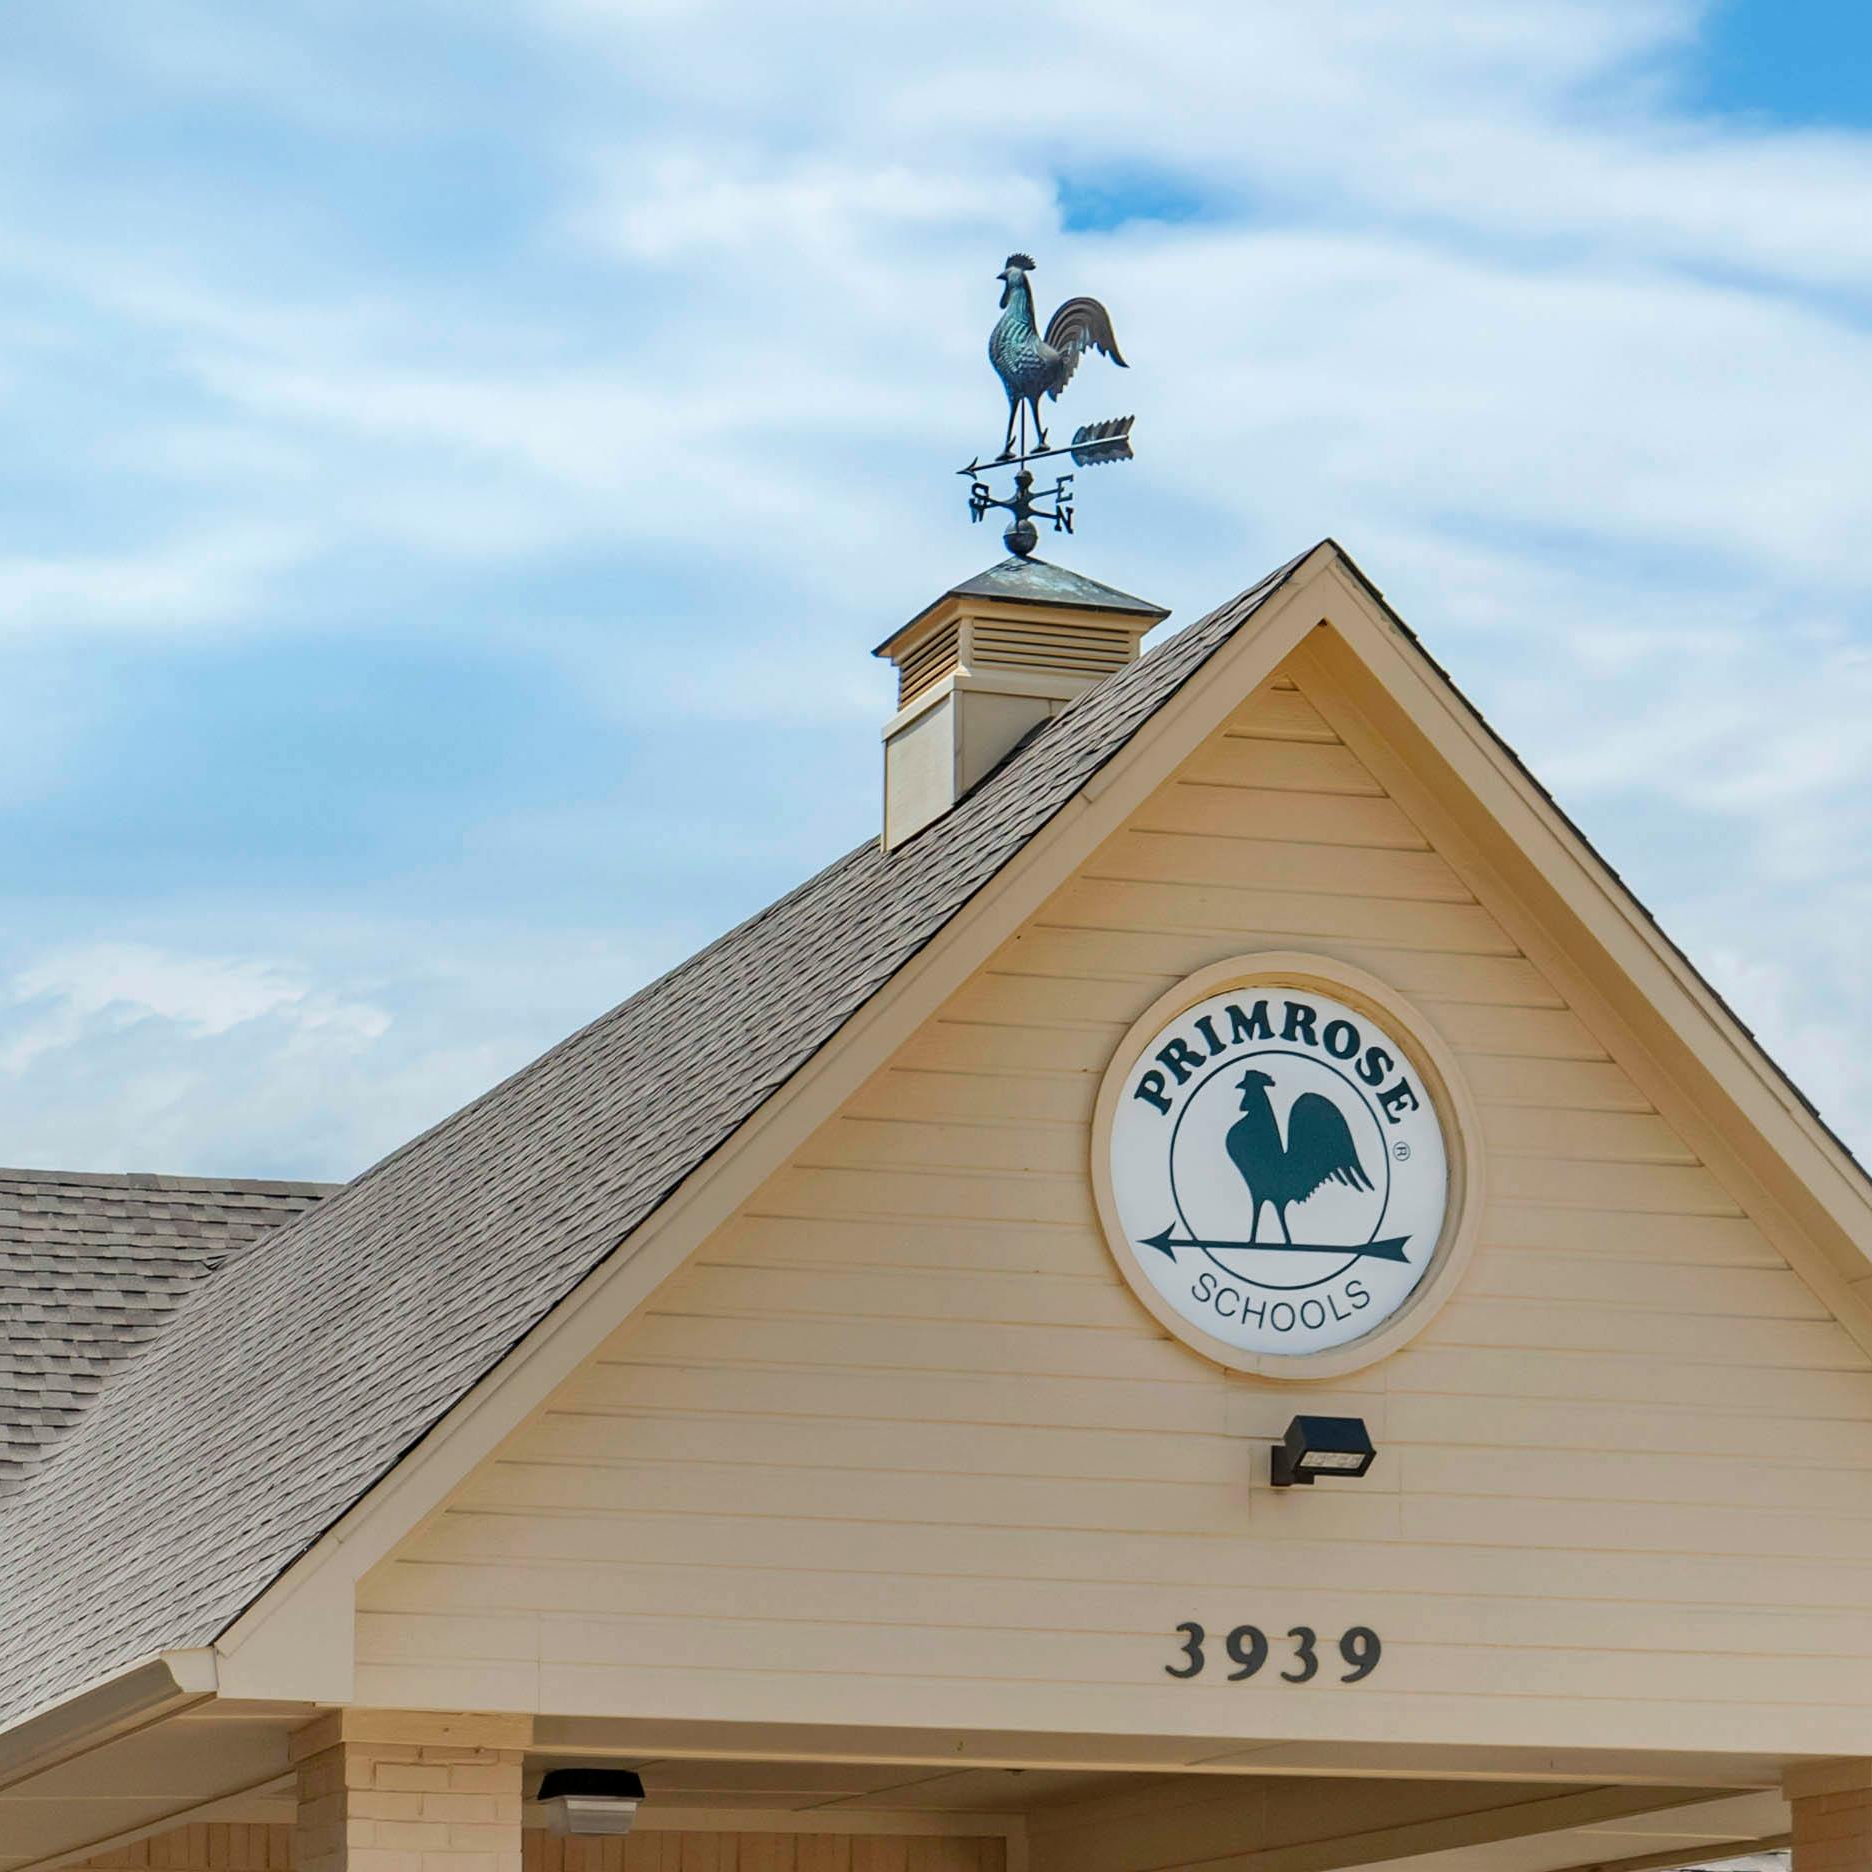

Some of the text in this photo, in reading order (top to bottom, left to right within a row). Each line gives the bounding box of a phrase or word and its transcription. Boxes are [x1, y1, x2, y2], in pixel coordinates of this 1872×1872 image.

[1054, 505, 1074, 534] N
[1133, 1000, 1419, 1125] PRIMROSE
[1191, 1272, 1371, 1332] SCHOOLS
[1165, 1621, 1382, 1684] 3939
